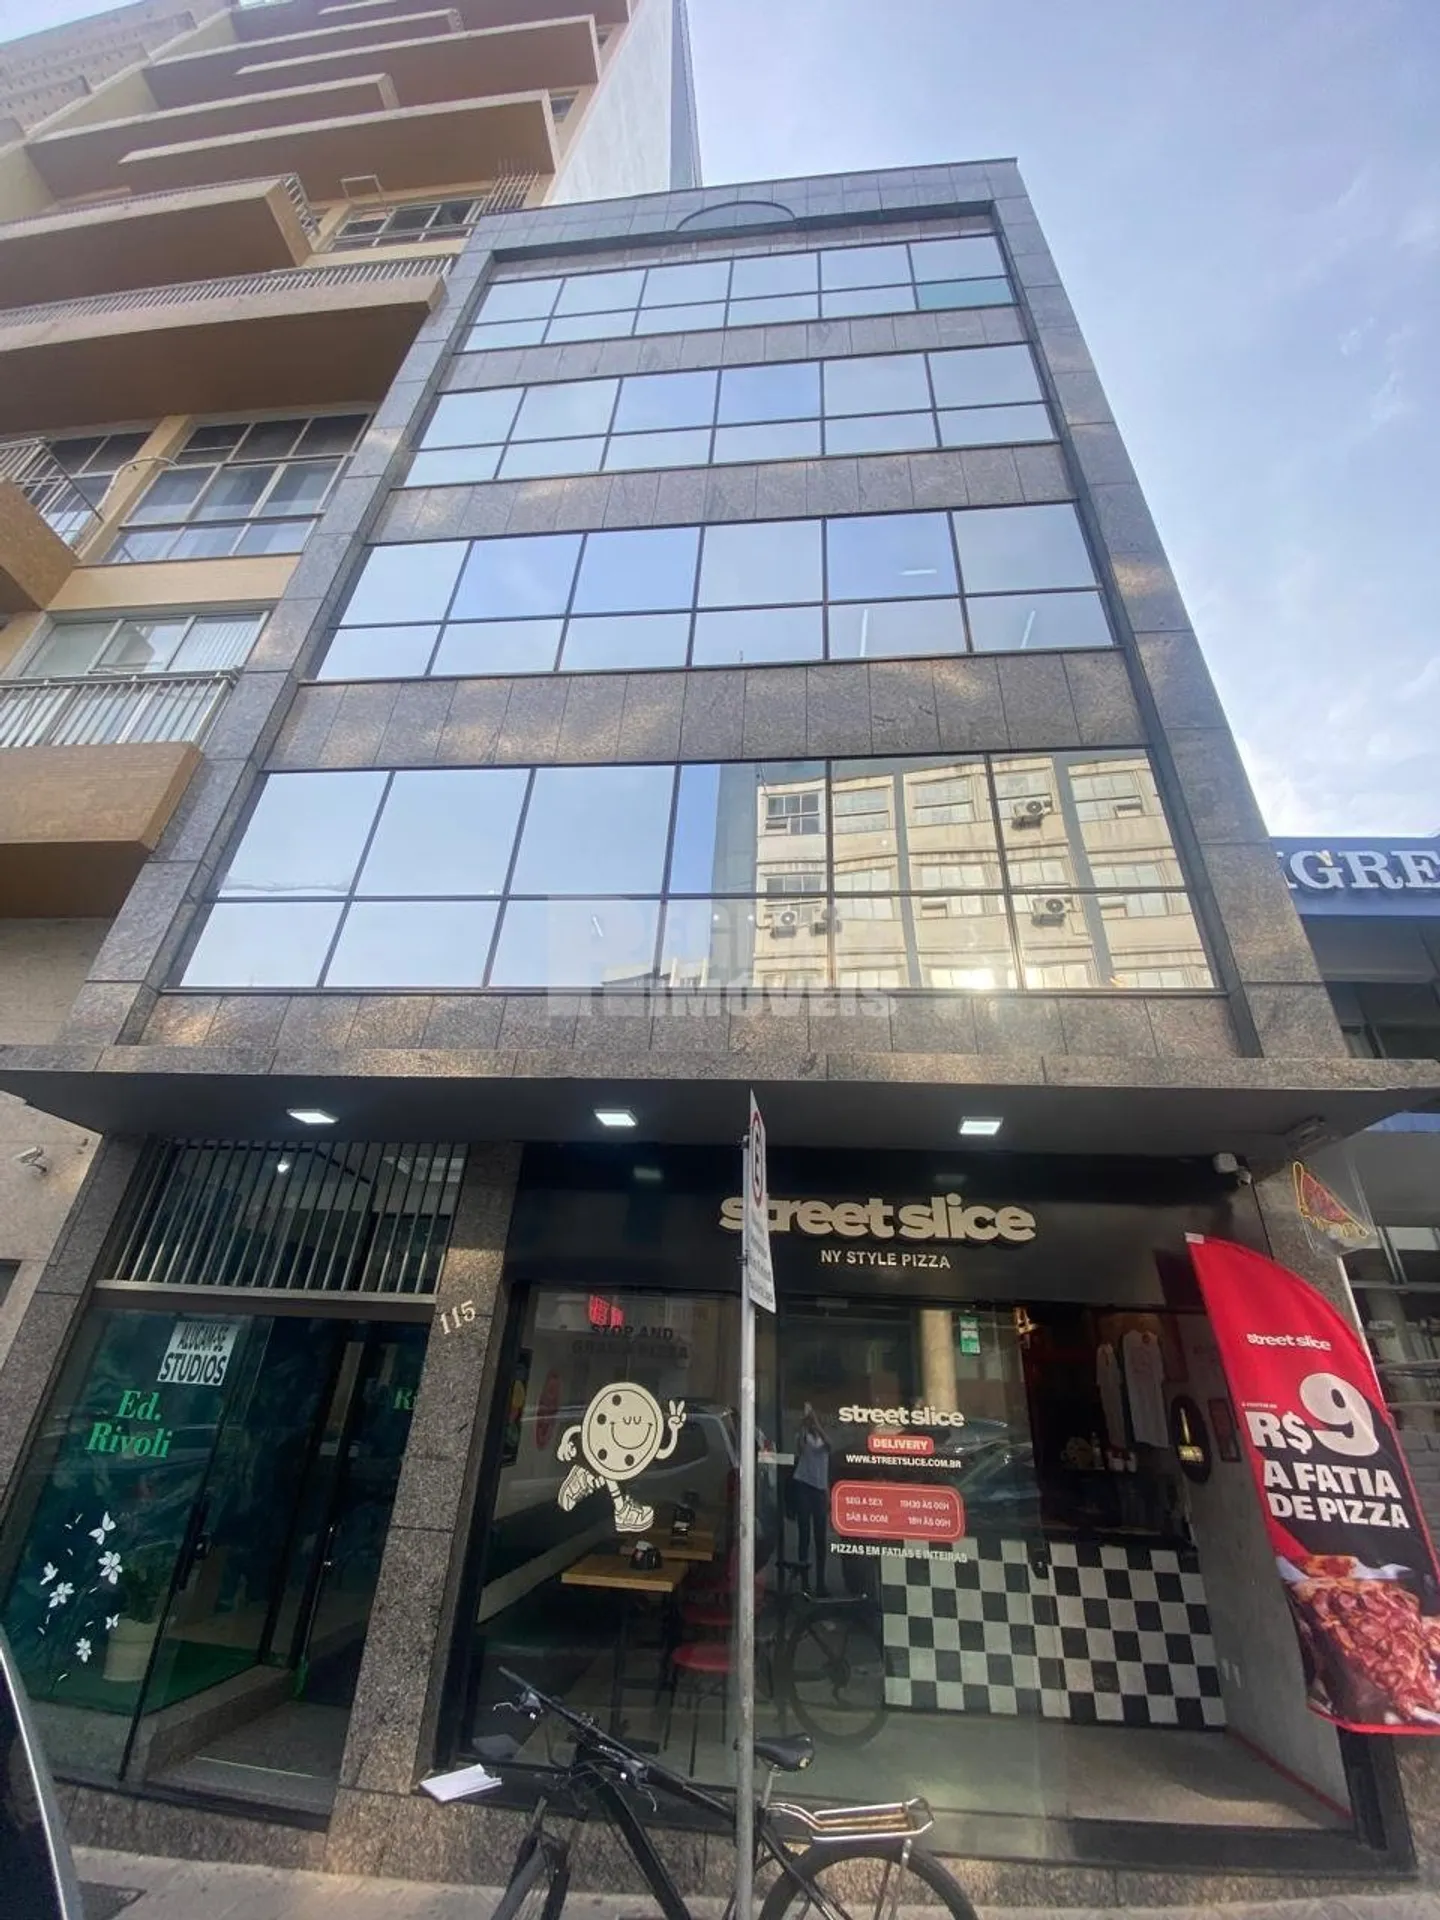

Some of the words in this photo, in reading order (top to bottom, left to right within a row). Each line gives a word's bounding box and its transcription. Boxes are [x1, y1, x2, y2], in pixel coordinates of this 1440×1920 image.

[1276, 850, 1440, 889] GRE
[719, 1196, 895, 1239] sreet
[898, 1192, 1037, 1242] slice
[821, 1250, 841, 1263] NY
[847, 1251, 897, 1266] STYLE
[902, 1254, 951, 1268] PIZZA
[440, 1300, 476, 1335] 115
[1246, 1333, 1296, 1346] street
[160, 1352, 227, 1384] STUDIOS
[115, 1390, 161, 1420] Ed.
[838, 1404, 909, 1425] street
[911, 1405, 965, 1427] slice
[84, 1422, 173, 1458] Rivoli
[872, 1438, 928, 1451] DELIVERY
[845, 1454, 962, 1468] WWW.STREETSLICE.COM.BR
[1263, 1459, 1293, 1489] A
[1292, 1461, 1402, 1499] FATIA
[1267, 1492, 1317, 1521] DE
[1317, 1497, 1410, 1529] PIZZA
[830, 1543, 865, 1555] PIZZAS
[866, 1545, 880, 1556] EM
[881, 1546, 915, 1558] FATIAS
